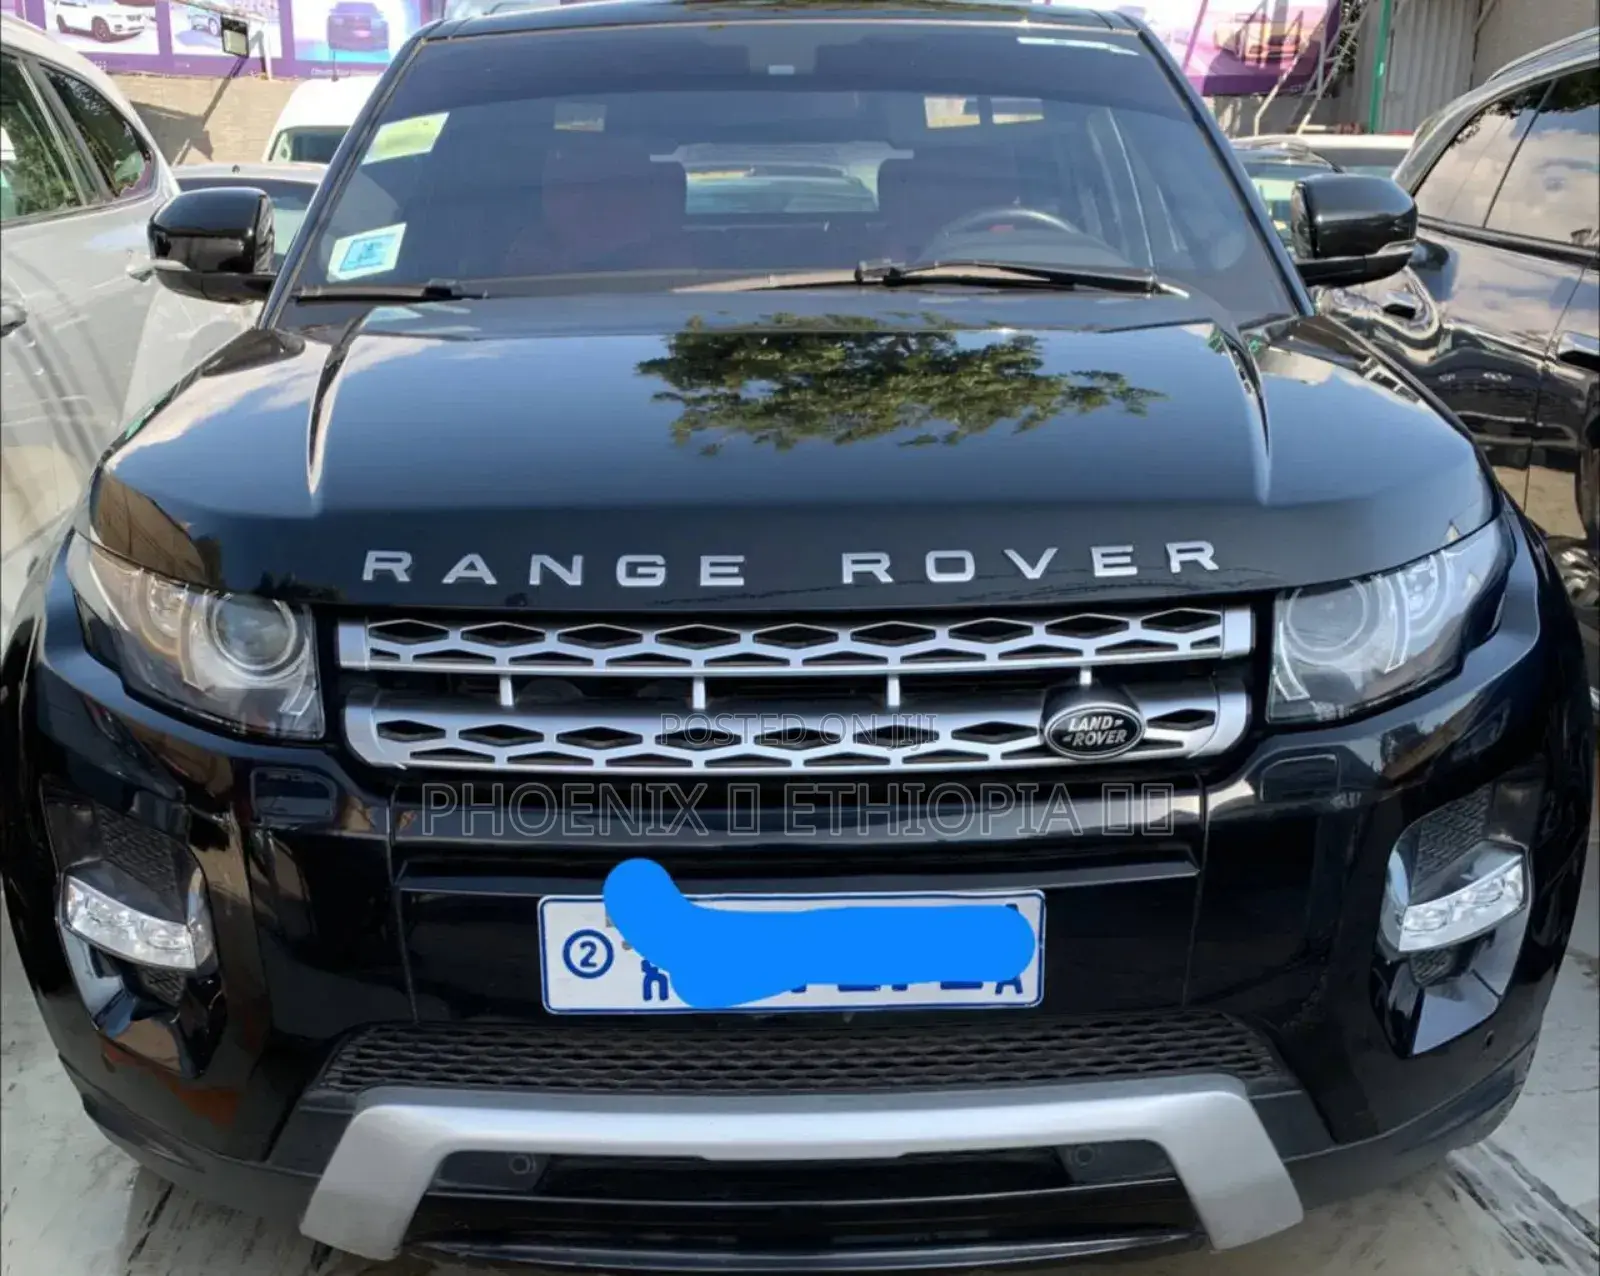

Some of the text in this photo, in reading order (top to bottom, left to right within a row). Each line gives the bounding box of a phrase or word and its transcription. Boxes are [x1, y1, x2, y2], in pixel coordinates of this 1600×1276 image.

[362, 540, 1220, 587] RANGE ROVER
[1068, 715, 1113, 732] LAND
[1071, 729, 1127, 747] ROVER
